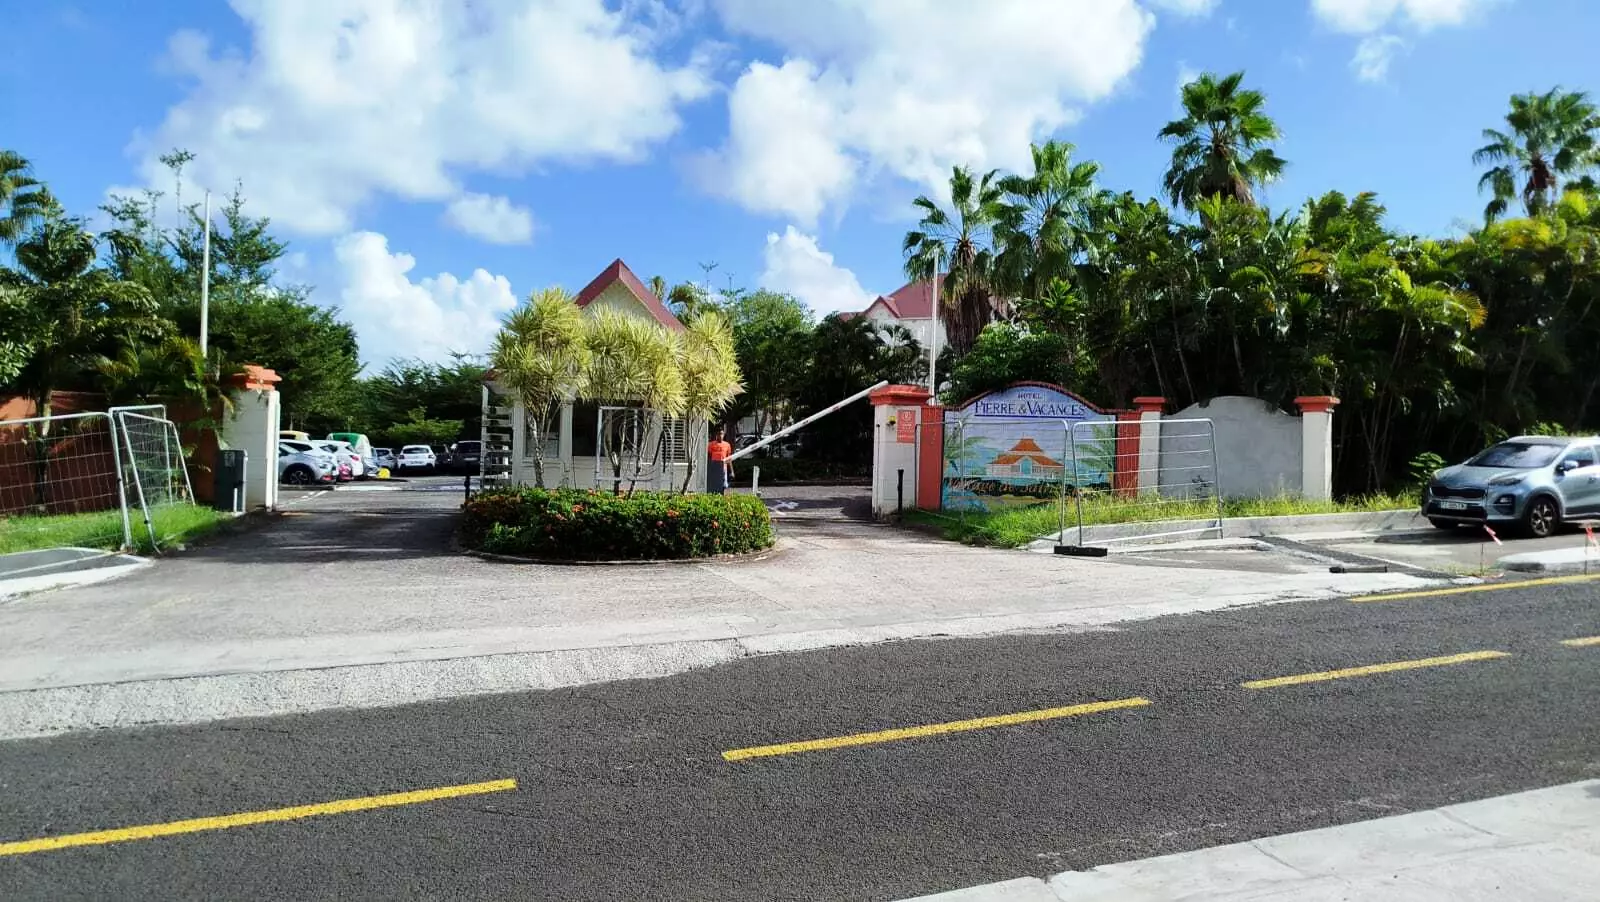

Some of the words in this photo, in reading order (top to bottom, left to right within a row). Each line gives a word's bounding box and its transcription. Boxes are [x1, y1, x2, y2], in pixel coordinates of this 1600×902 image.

[975, 400, 1016, 415] PIERRE
[1018, 403, 1027, 415] &
[1027, 401, 1085, 416] VACANCES
